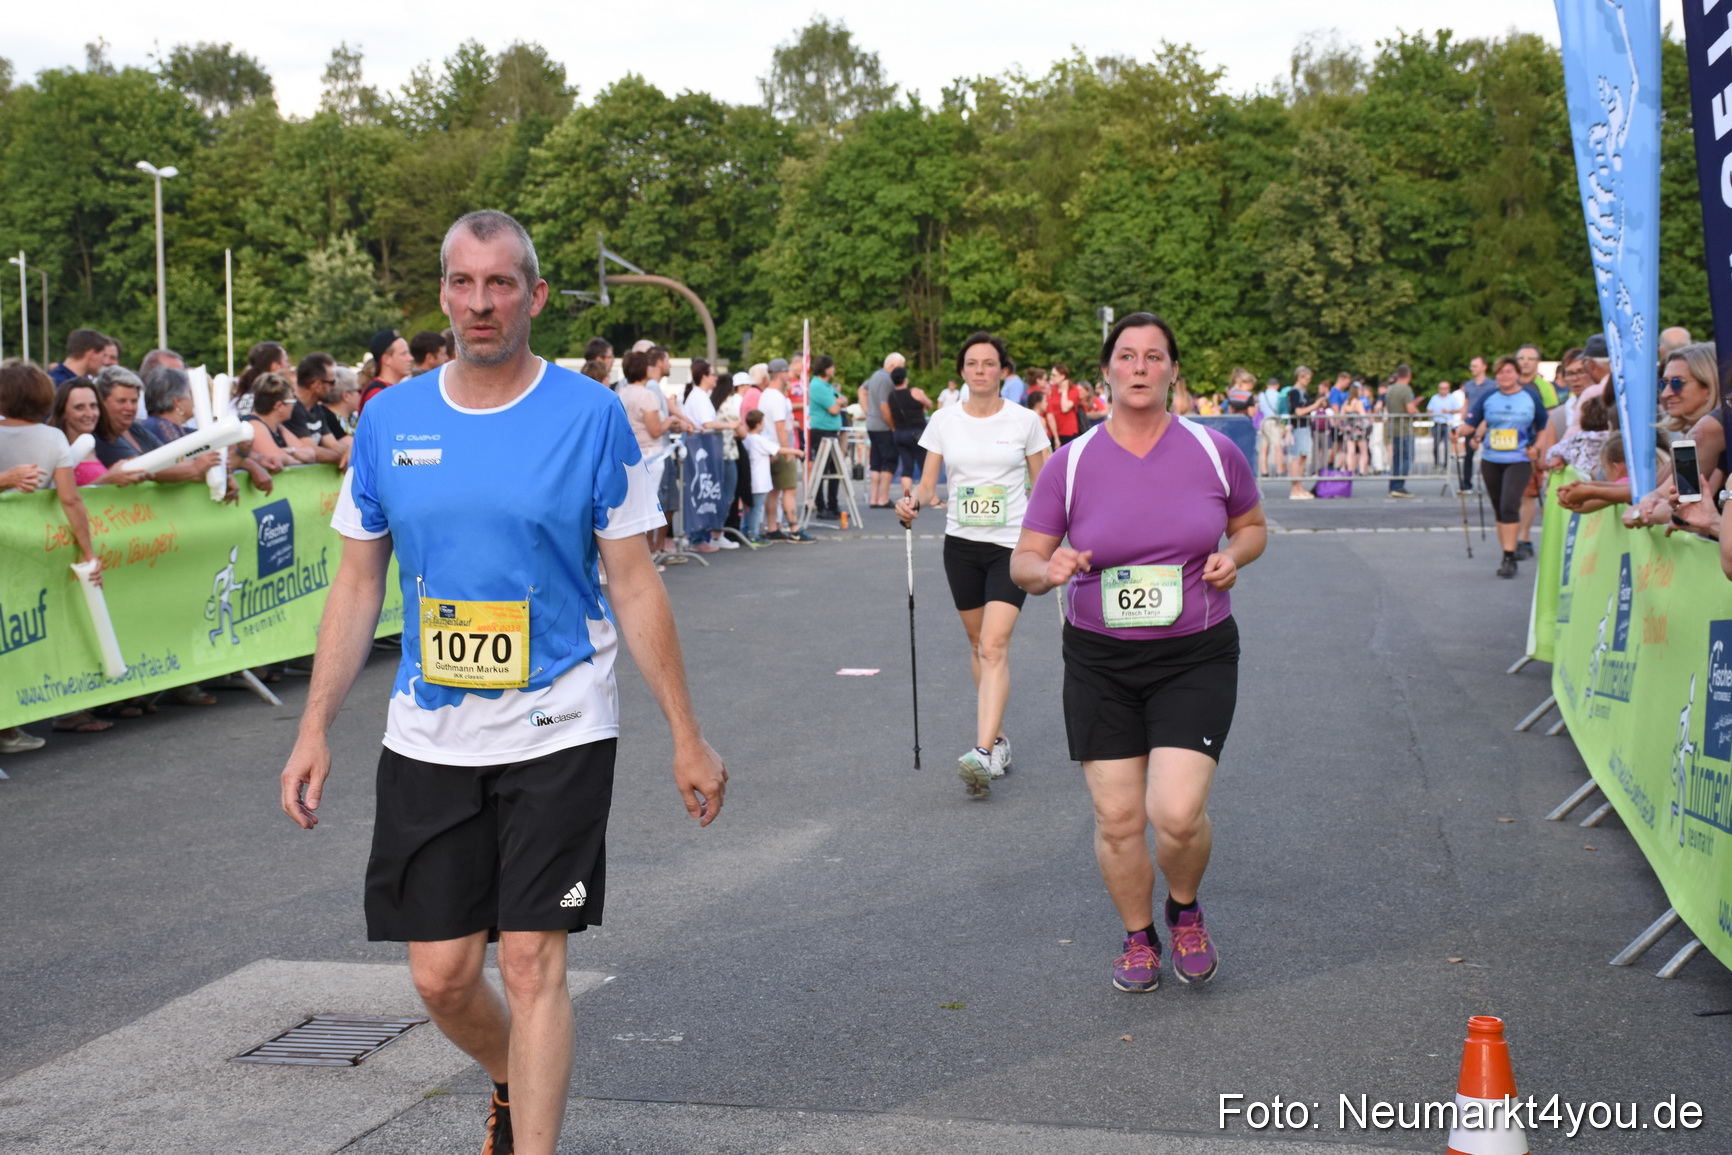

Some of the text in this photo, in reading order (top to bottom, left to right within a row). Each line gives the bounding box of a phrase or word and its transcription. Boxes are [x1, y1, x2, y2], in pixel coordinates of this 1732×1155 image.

[413, 457, 441, 466] classic
[962, 500, 1000, 514] 1025
[263, 523, 290, 541] Fischer
[241, 546, 329, 621] firmenlauf
[1118, 587, 1163, 610] 629
[243, 609, 286, 636] neumarkt
[432, 630, 512, 663] 1070
[435, 662, 509, 674] Guthmann Markus
[553, 710, 582, 723] classic
